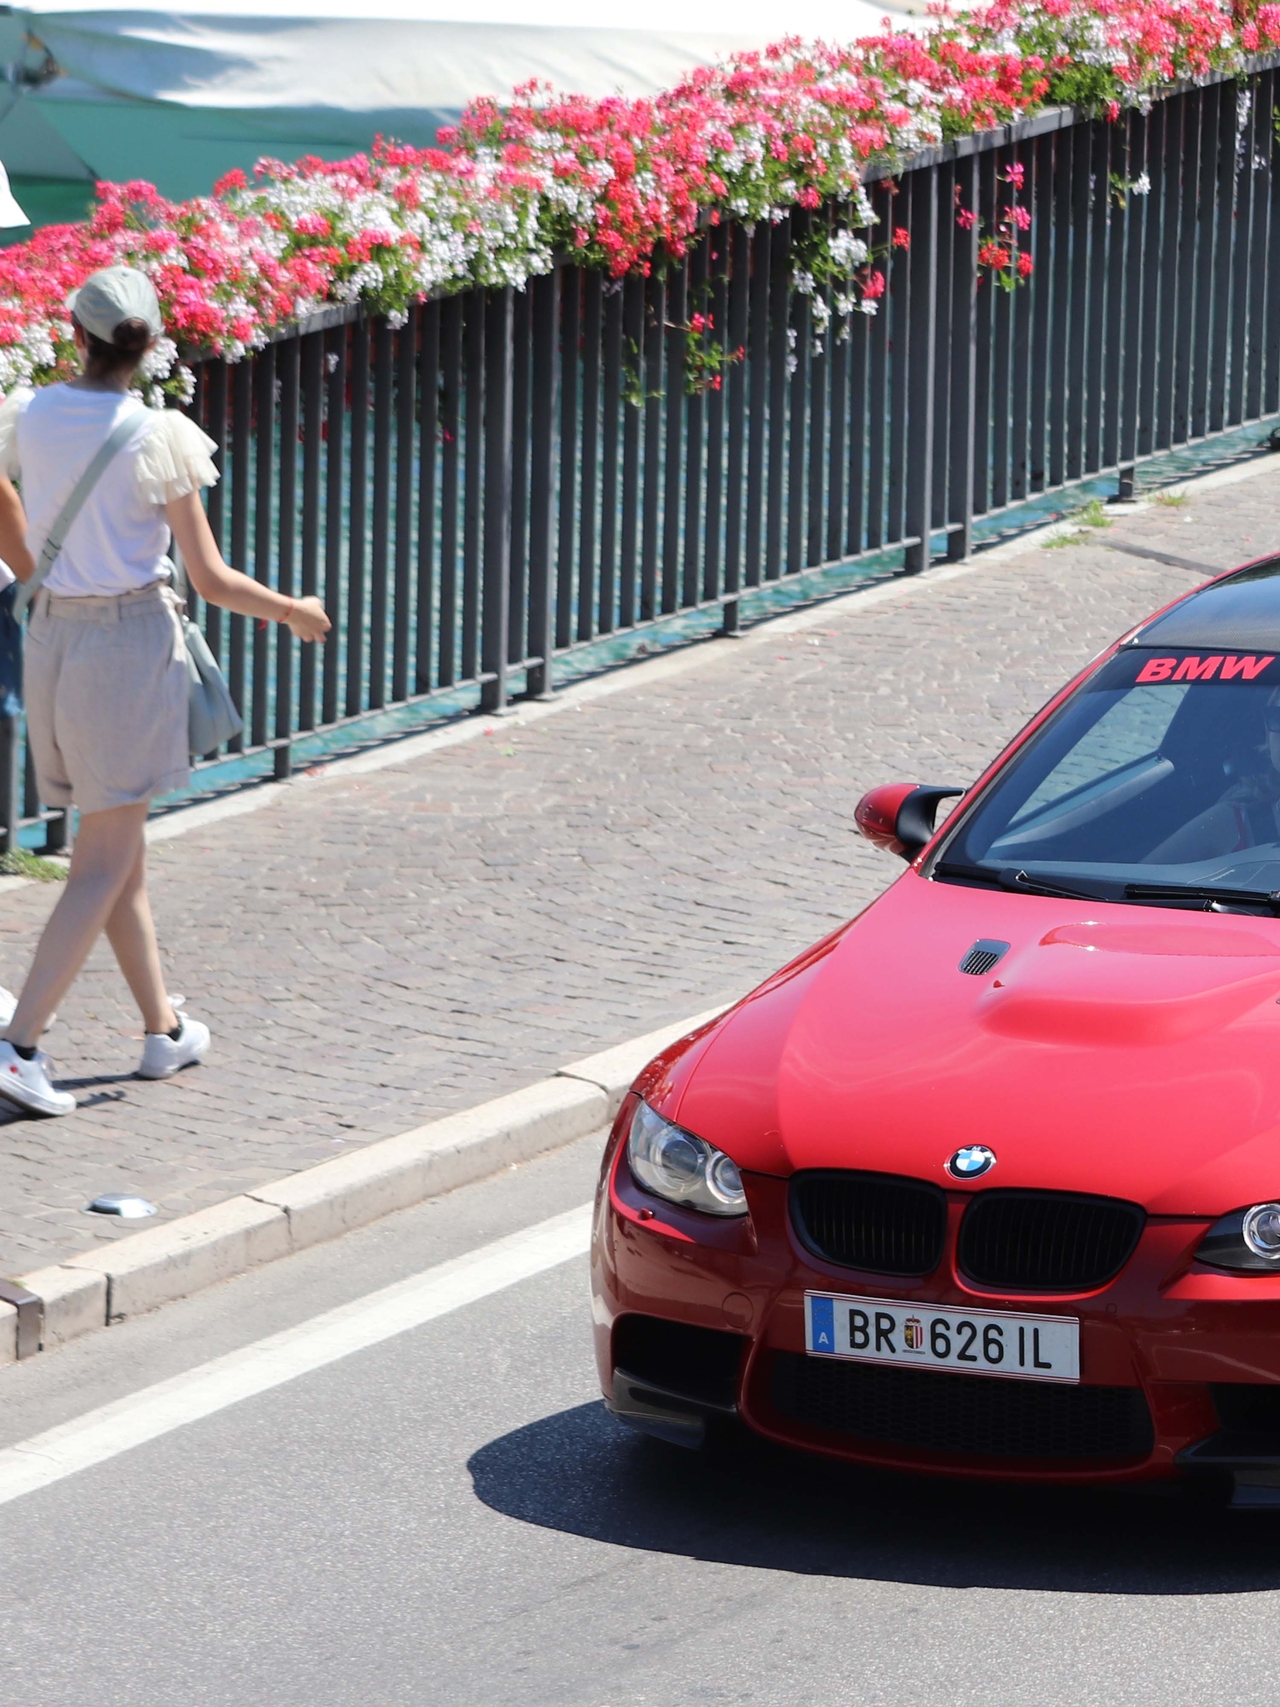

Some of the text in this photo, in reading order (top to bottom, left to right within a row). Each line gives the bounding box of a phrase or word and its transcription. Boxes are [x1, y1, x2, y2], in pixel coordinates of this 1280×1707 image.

[1135, 655, 1276, 683] BMW
[818, 1332, 829, 1345] A
[849, 1308, 1053, 1369] BR 626 IL
